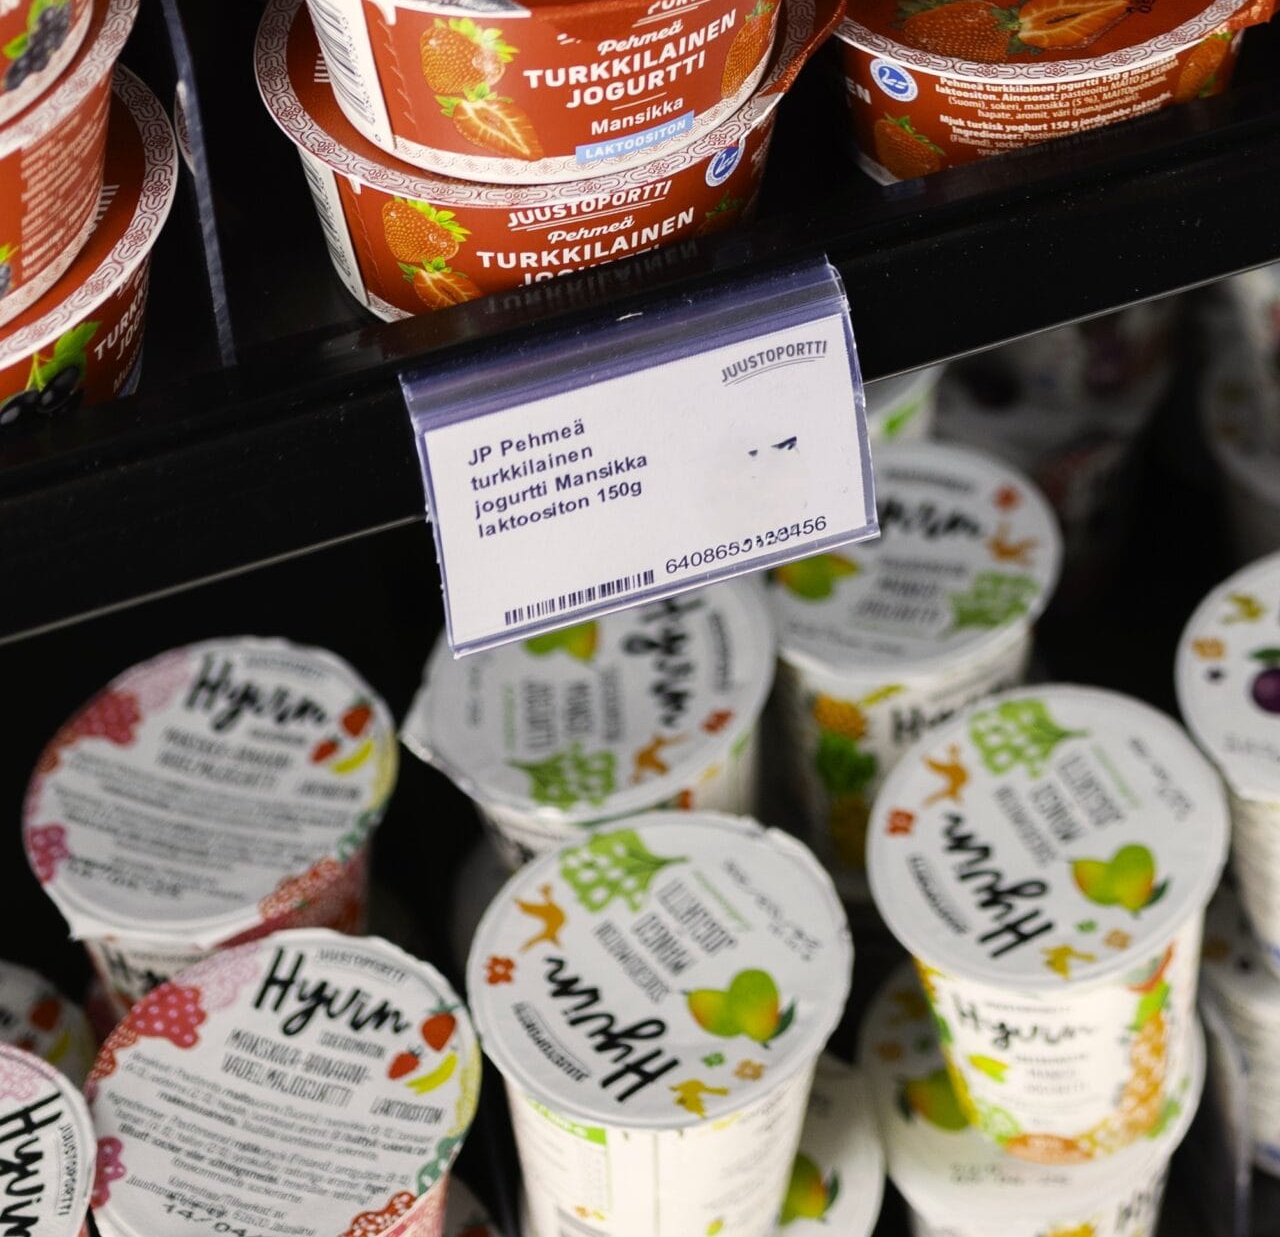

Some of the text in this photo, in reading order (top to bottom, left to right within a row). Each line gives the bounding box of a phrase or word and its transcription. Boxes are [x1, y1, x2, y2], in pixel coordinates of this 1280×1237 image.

[523, 8, 737, 90] TURKKILAINEN
[597, 18, 684, 57] Pehmeä
[566, 49, 706, 110] JOGURTTI
[935, 84, 1000, 102] laktoositon.
[1002, 92, 1060, 102] Ainesosat:
[985, 82, 1055, 93] turkkilainen
[1056, 75, 1100, 93] jogurtti
[1102, 73, 1120, 85] 150
[590, 95, 685, 136] Mansikka
[966, 119, 1004, 131] turkisk
[1004, 121, 1049, 132] yoghurt
[1050, 120, 1069, 130] 150
[1023, 99, 1070, 111] mansikka
[584, 117, 688, 161] LAKTOOSITON
[507, 179, 673, 229] JUUSTOPORTTI
[476, 206, 696, 268] TURKKILAINEN
[547, 215, 636, 245] Pehmeä
[720, 339, 828, 383] JUUSTOPORTTI
[467, 419, 586, 467] JP Pehmeä
[470, 445, 594, 493] turkkilainen
[474, 453, 648, 519] jogurtti Mansikka
[478, 479, 643, 539] laktoositon 150g
[942, 811, 1056, 960] Hyvin
[254, 946, 411, 1036] Hyvin
[543, 956, 679, 1104] Hyvin
